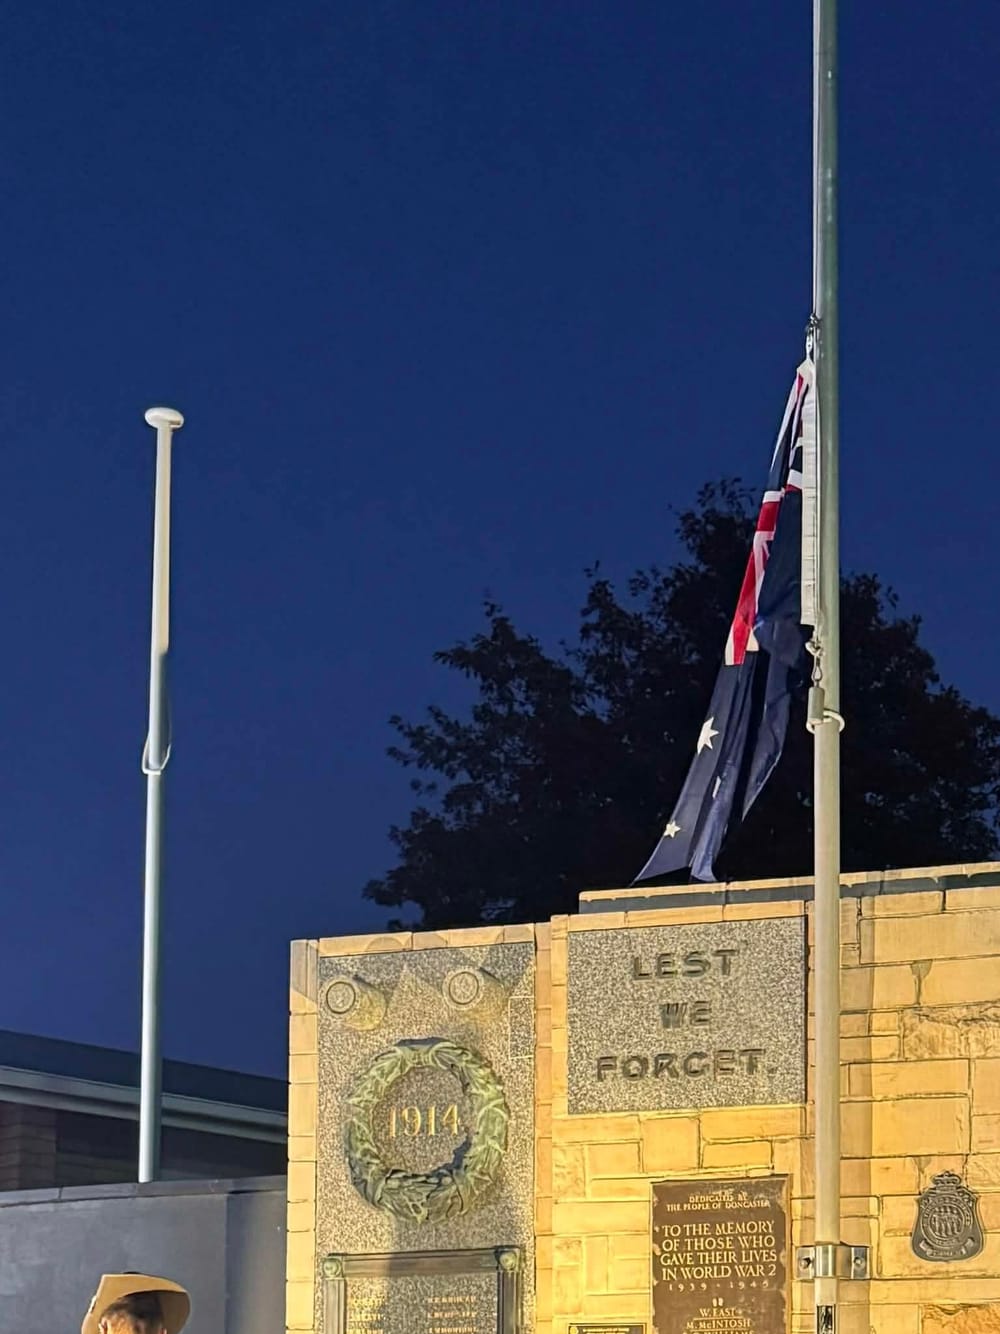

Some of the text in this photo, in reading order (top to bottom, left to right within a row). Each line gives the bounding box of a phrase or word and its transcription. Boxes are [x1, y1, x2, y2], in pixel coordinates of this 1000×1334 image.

[631, 949, 738, 980] LEST
[660, 1001, 712, 1029] WE
[389, 1104, 460, 1137] 1914
[666, 1203, 682, 1212] THE
[683, 1202, 711, 1211] PEOPLE
[725, 1199, 771, 1209] DONCASTER
[662, 1220, 774, 1237] TO THE MEMORY
[662, 1234, 775, 1251] OF THOSE WHO
[660, 1249, 777, 1266] GAVE THEIR LIVES
[662, 1264, 777, 1280] IN WORLD WAR 2
